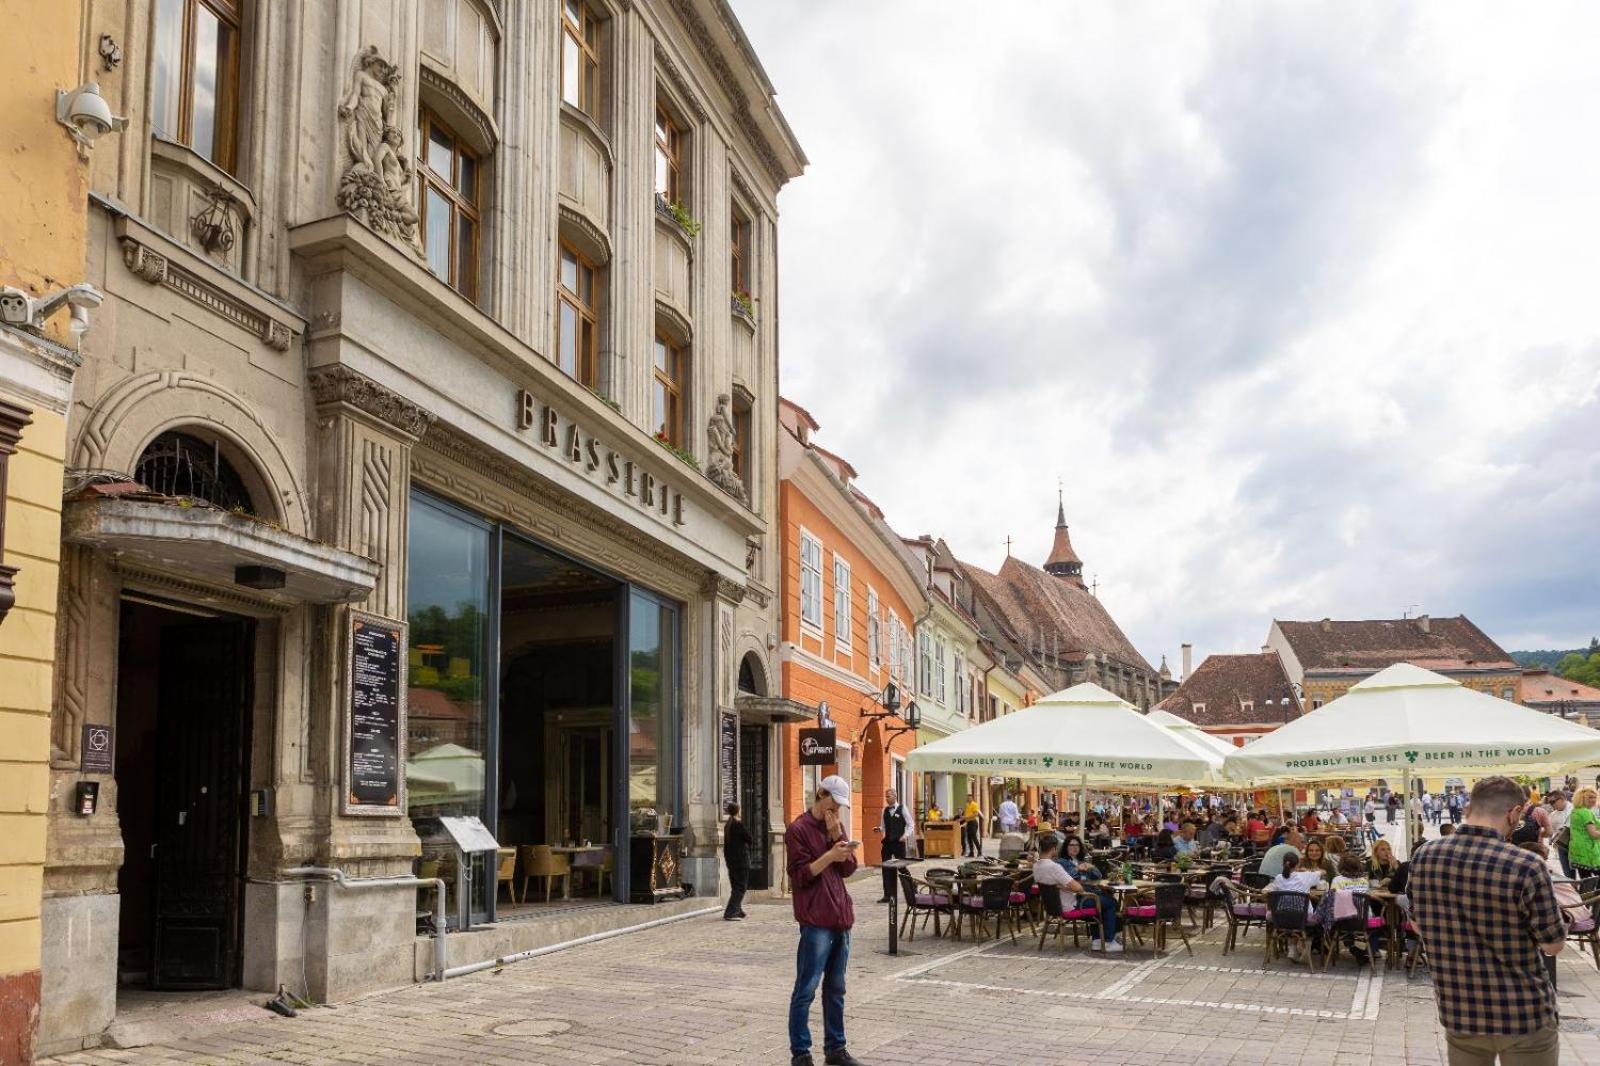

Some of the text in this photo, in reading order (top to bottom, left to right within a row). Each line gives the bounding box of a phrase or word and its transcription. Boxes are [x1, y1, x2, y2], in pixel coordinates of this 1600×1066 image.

[517, 389, 686, 526] BRASSERIE
[952, 758, 995, 766] PROBABLY
[998, 758, 1014, 766] THE
[1058, 759, 1081, 768] BEER
[1085, 760, 1094, 768] IN
[1097, 761, 1116, 769] THE
[1120, 762, 1153, 771] WORLD
[1286, 747, 1551, 768] PROBABLY THE BEST BEER IN THE WORLD
